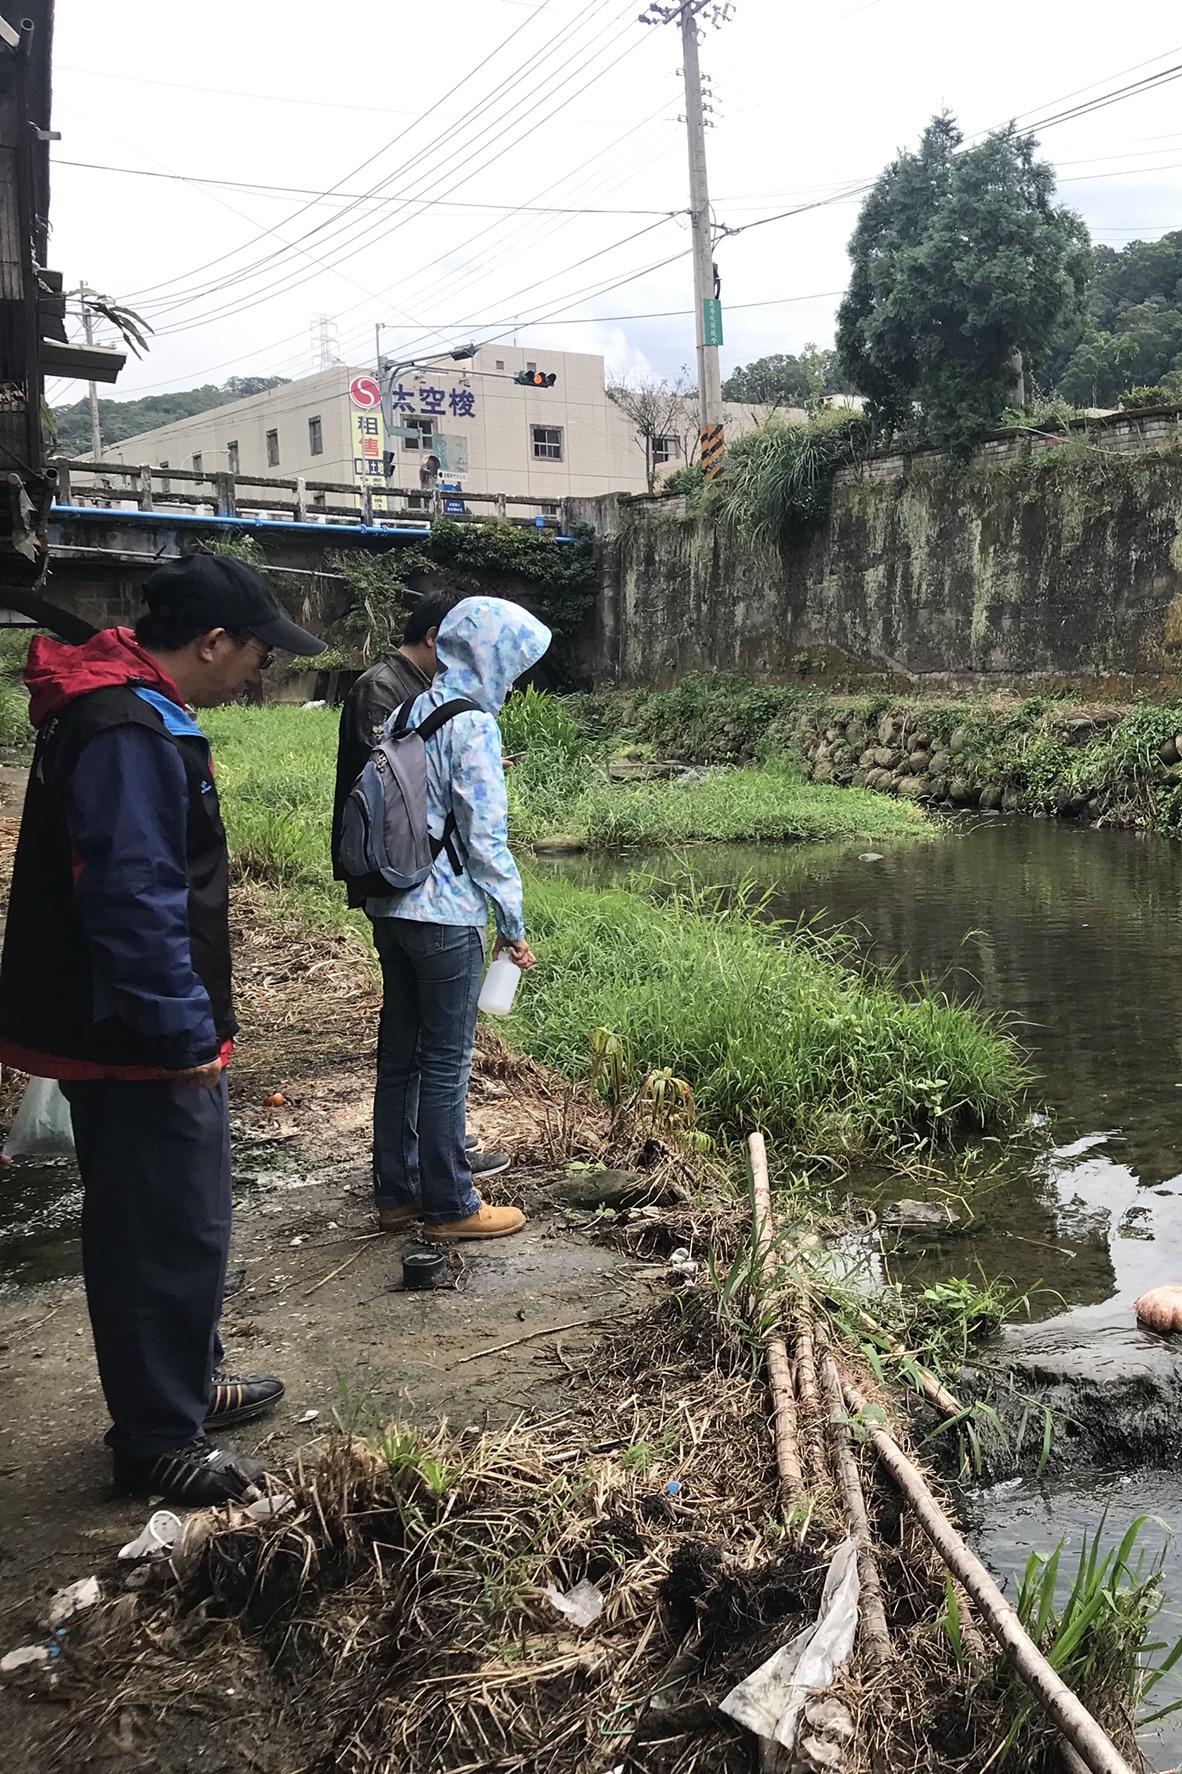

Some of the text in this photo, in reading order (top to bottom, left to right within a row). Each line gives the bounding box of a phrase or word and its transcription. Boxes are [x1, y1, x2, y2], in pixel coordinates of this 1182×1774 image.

[393, 383, 475, 418] 太空梭
[358, 416, 379, 457] 租售
